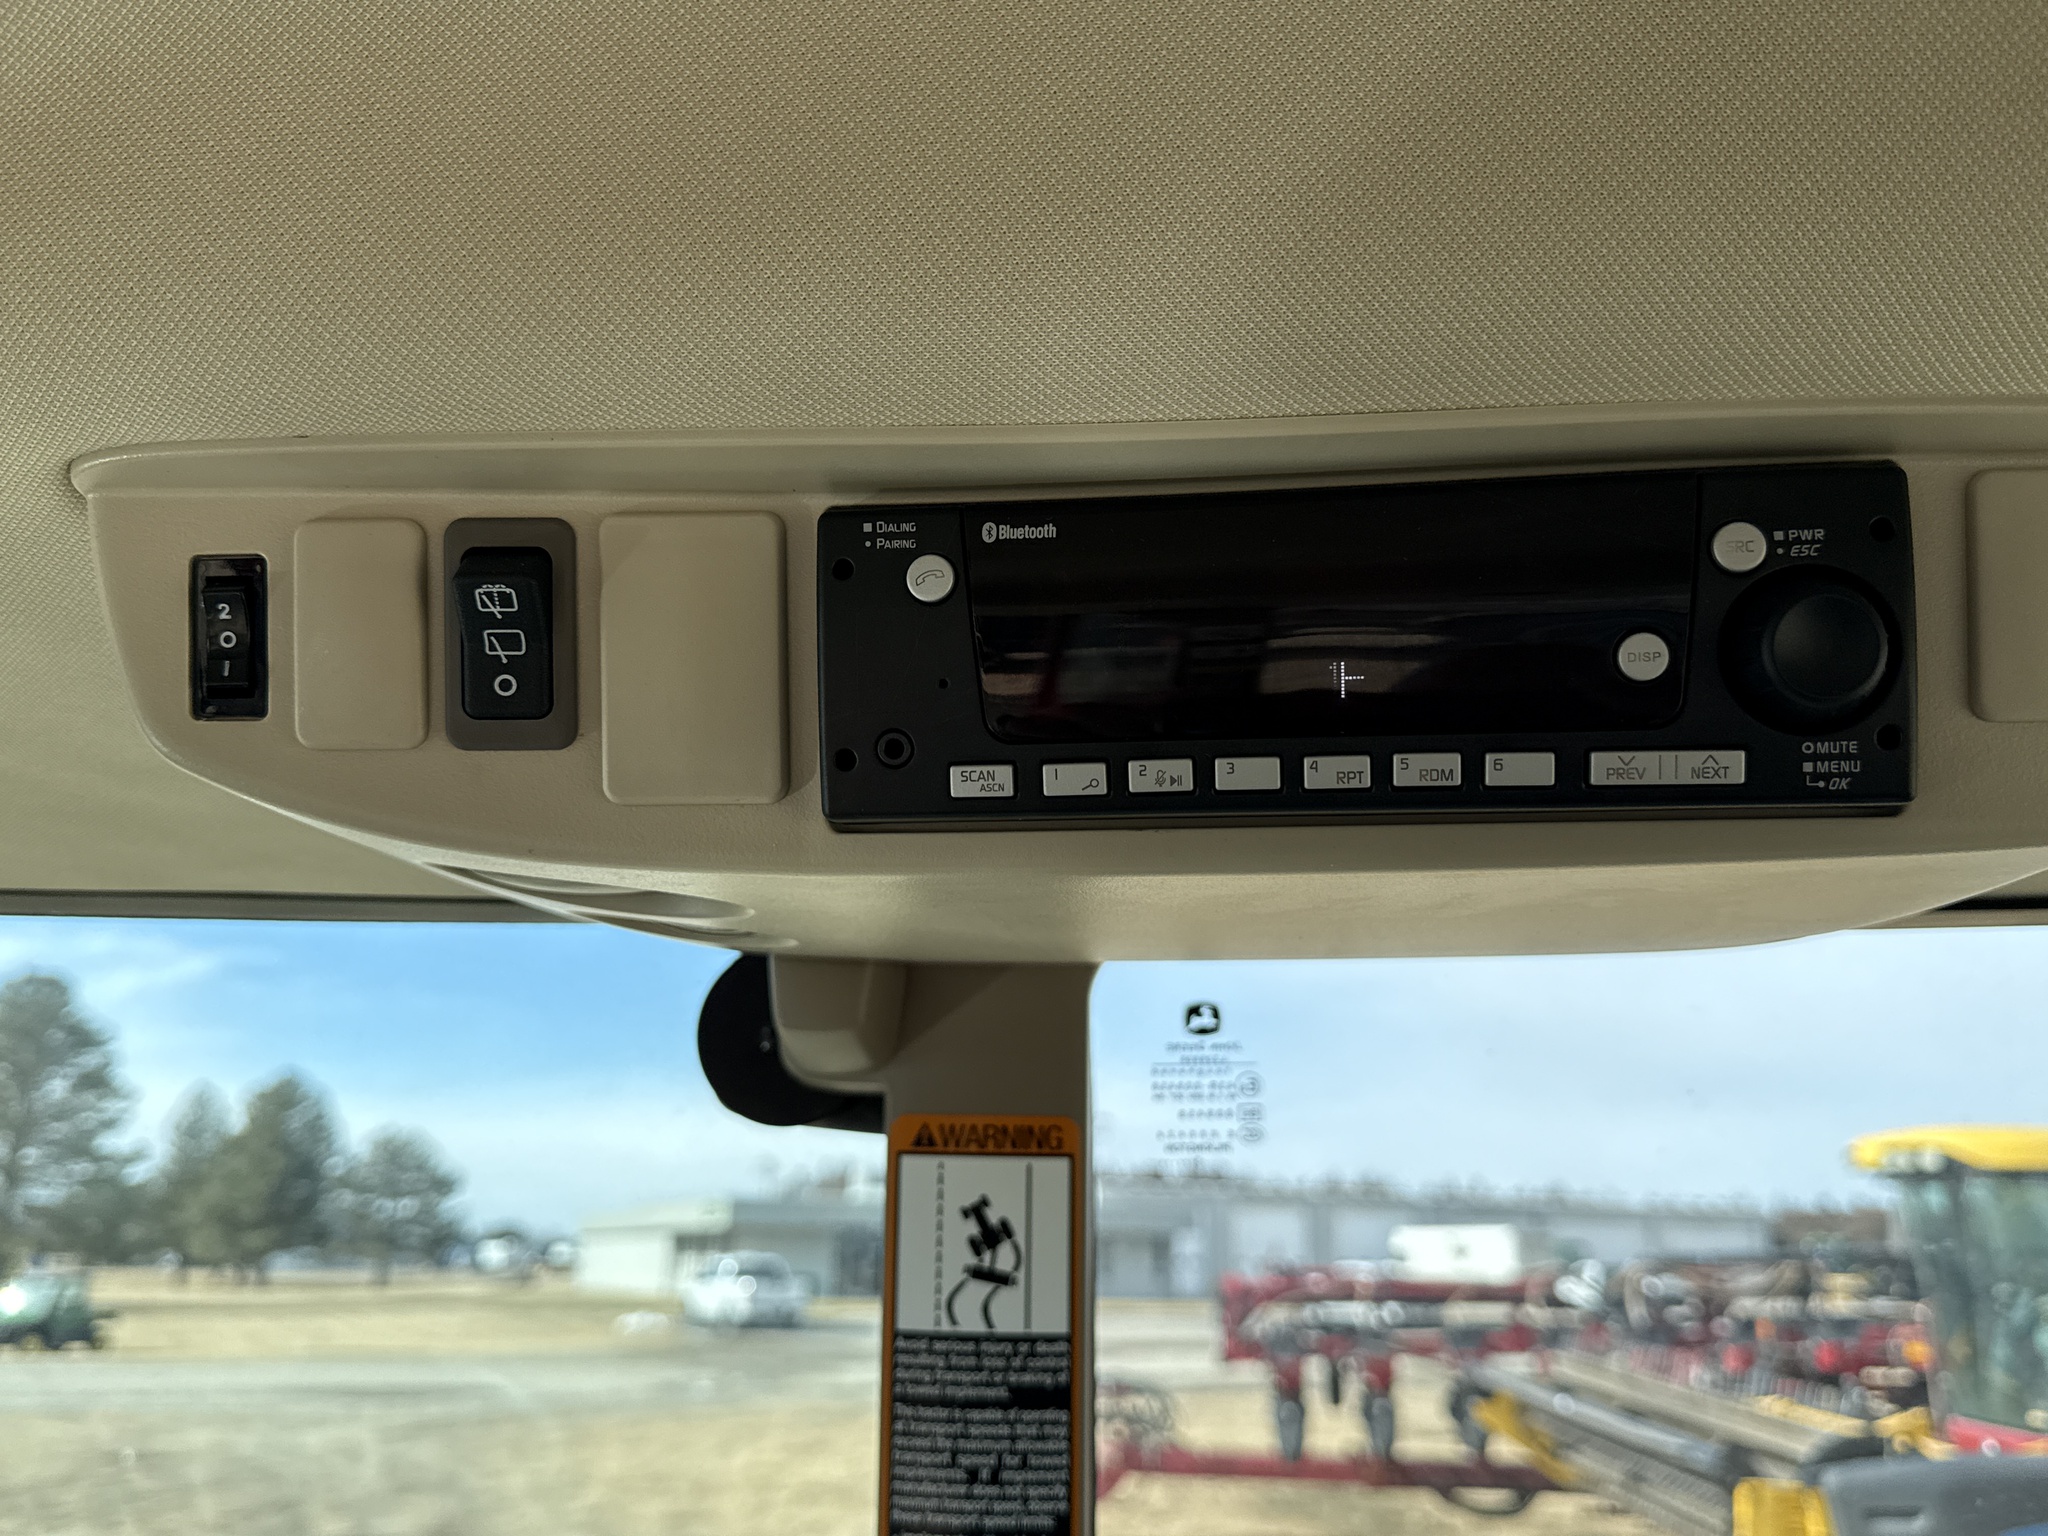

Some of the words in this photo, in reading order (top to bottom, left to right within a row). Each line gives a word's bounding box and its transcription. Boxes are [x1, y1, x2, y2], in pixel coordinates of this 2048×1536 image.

[876, 521, 917, 533] DIALING
[998, 522, 1057, 540] Bluetooth
[1788, 529, 1825, 542] PWR
[876, 538, 917, 550] PAIRING
[1790, 544, 1821, 557] ESC
[218, 603, 232, 620] 2
[1627, 651, 1662, 663] DISP
[1816, 741, 1858, 754] MUTE
[1226, 762, 1236, 775] 3
[1309, 760, 1319, 773] 4
[1400, 757, 1410, 770] 5
[1493, 758, 1504, 772] 6
[1816, 760, 1861, 773] MENU
[960, 769, 996, 783] SCAN
[1138, 764, 1148, 777] 2
[1418, 768, 1454, 782] RDM
[1605, 767, 1646, 780] PREV
[1691, 766, 1730, 780] NEXT
[1336, 770, 1365, 785] RPT
[1829, 777, 1850, 790] OK
[979, 782, 1005, 793] ASCN
[939, 1122, 1064, 1149] WARNING
